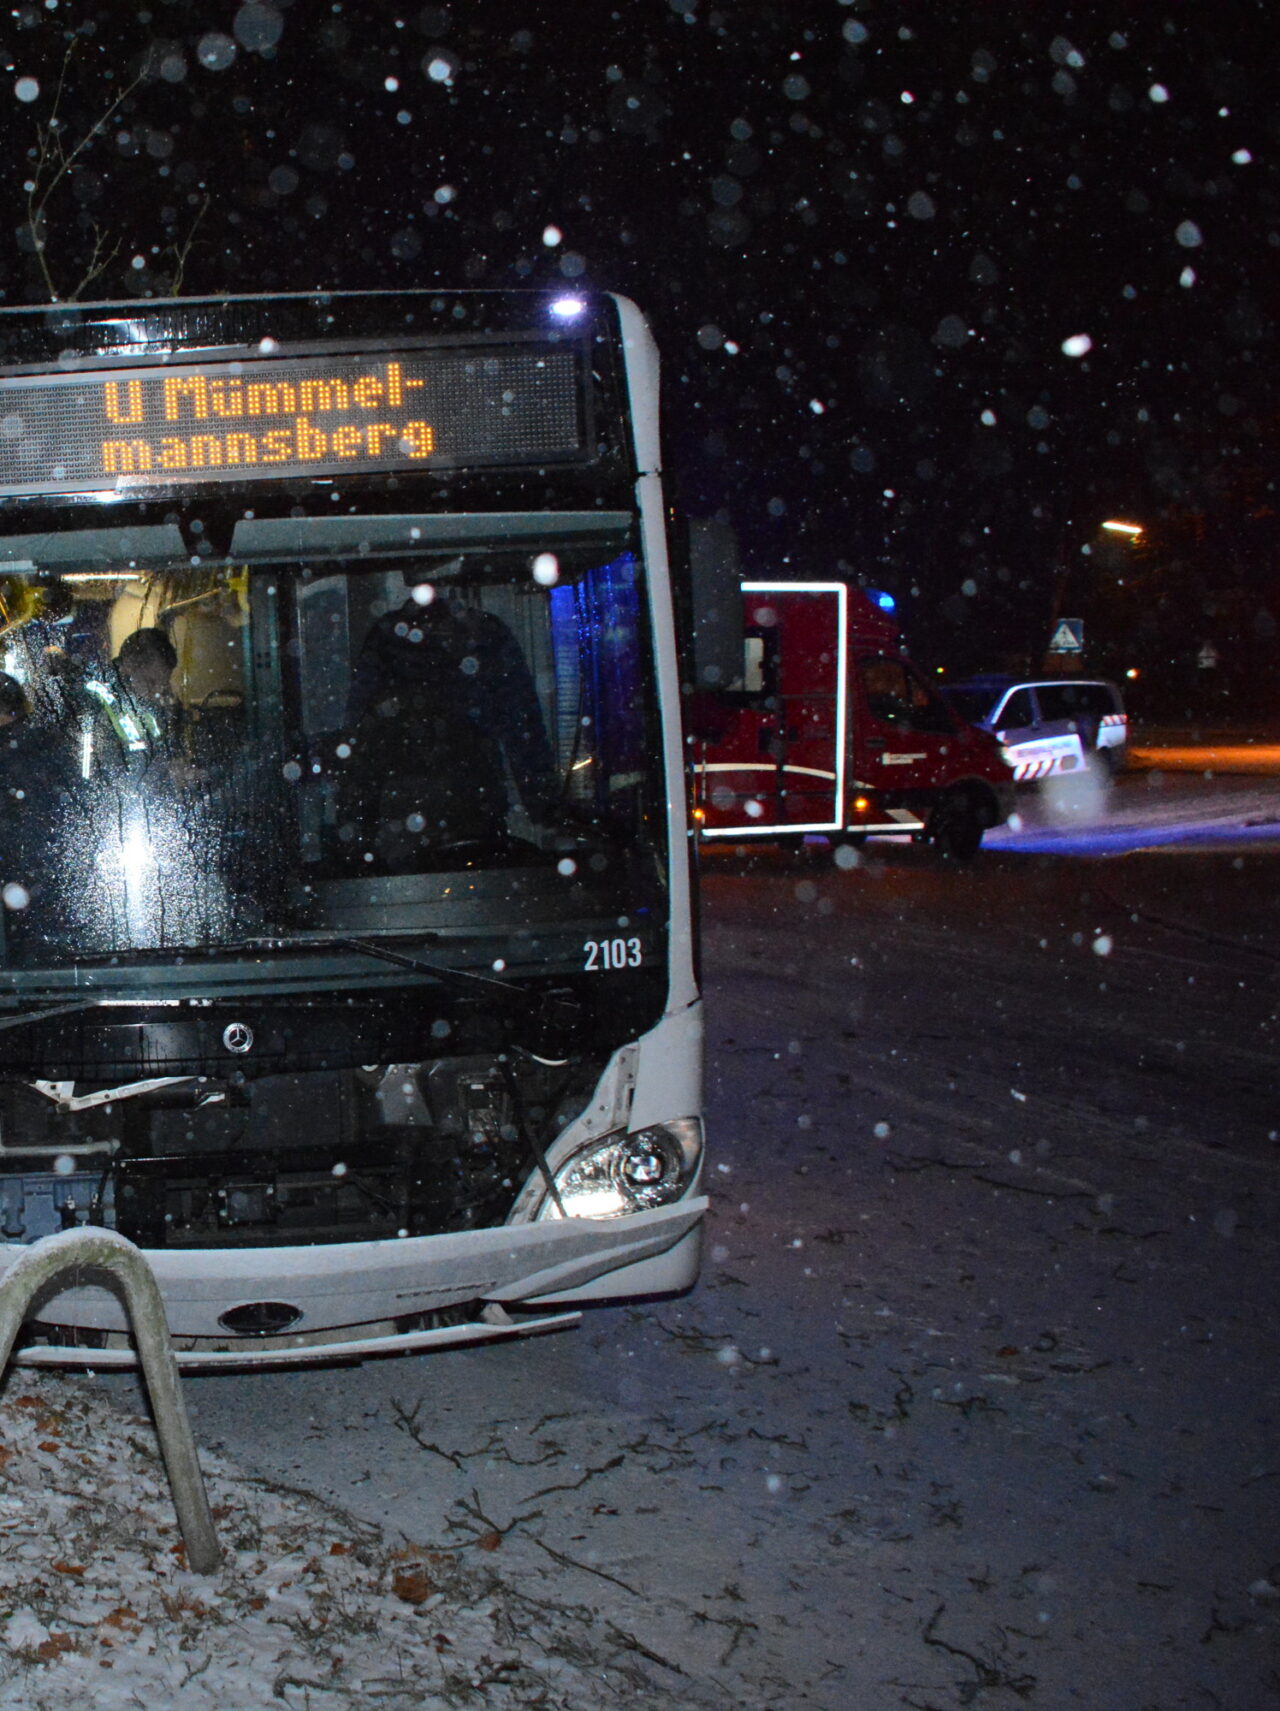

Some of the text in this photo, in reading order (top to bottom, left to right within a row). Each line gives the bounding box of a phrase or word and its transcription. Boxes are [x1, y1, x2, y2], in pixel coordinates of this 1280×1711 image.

[104, 362, 424, 424] U Mümmel-
[102, 416, 434, 473] mannsberg
[583, 937, 642, 971] 2103
